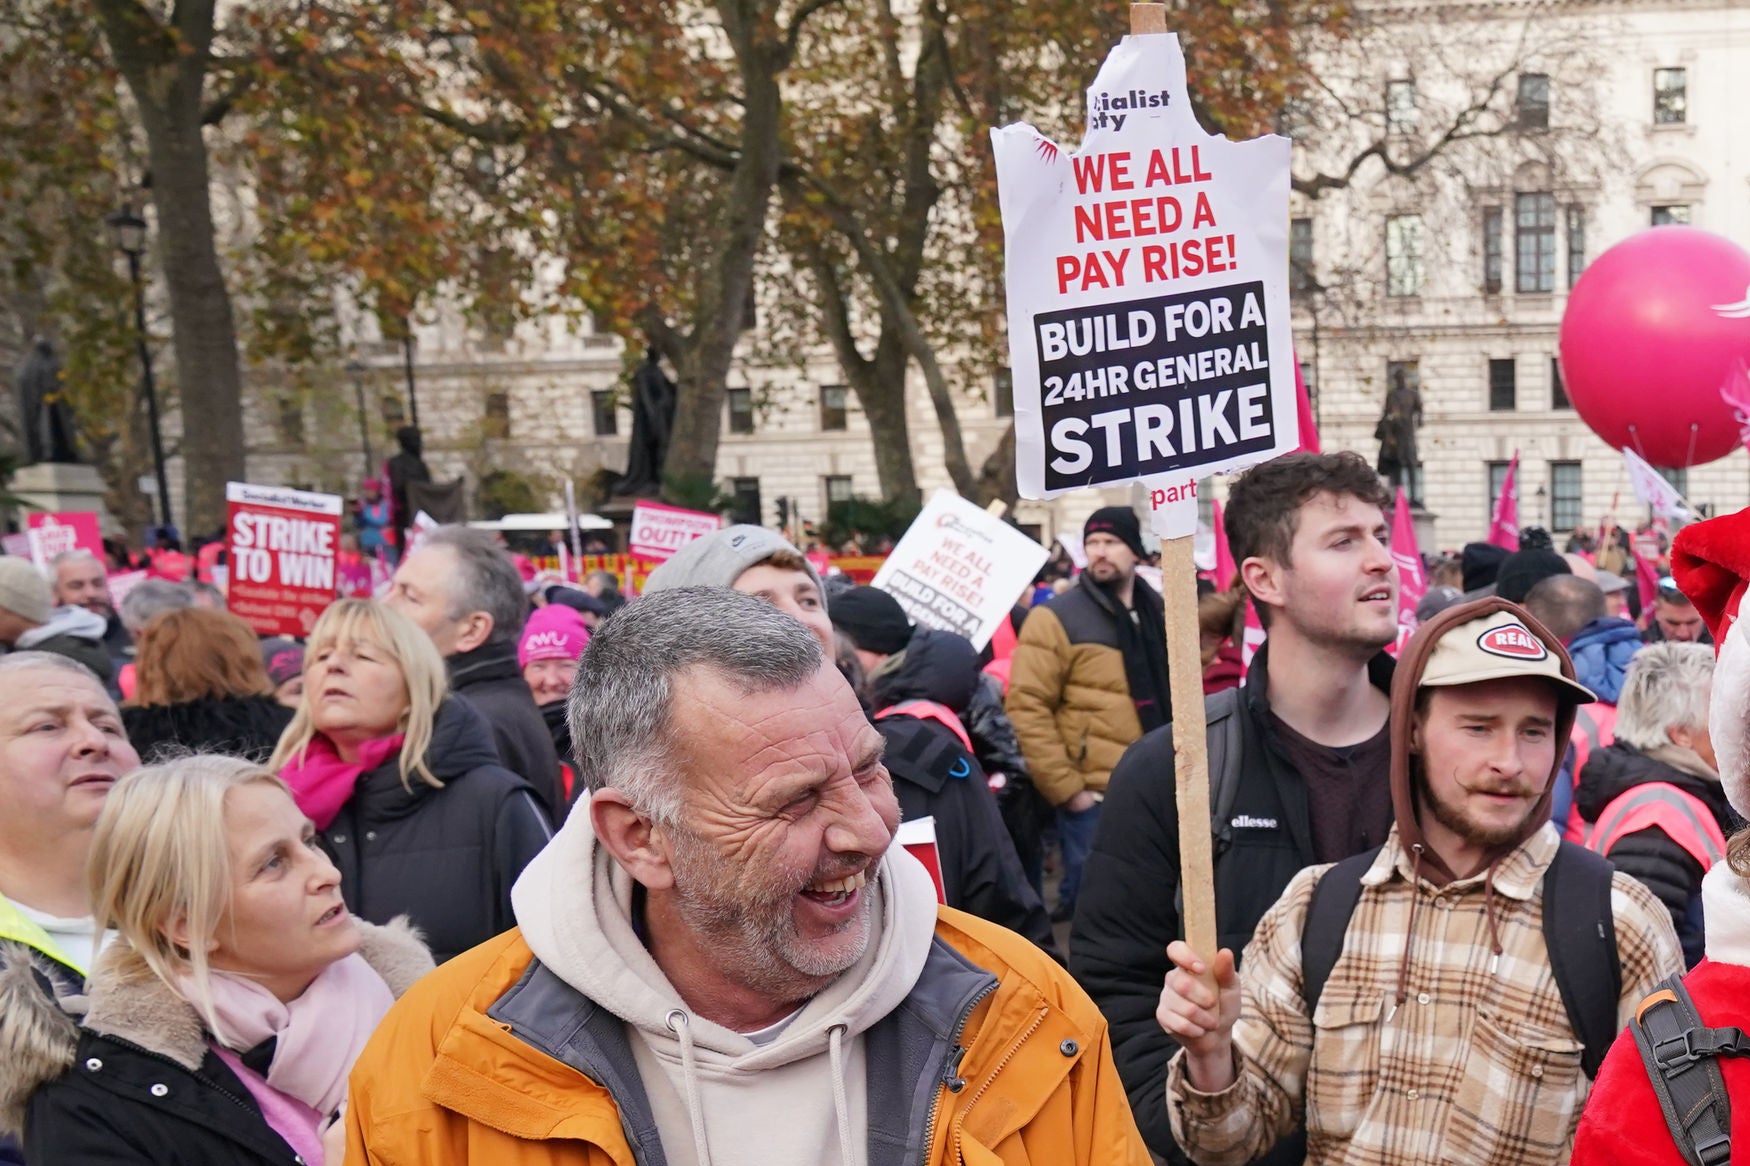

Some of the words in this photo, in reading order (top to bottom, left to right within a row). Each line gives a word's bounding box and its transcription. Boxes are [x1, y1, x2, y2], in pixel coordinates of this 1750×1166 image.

[1094, 90, 1170, 111] ialist
[1072, 152, 1134, 195] WE
[1145, 145, 1212, 187] ALL
[1074, 196, 1182, 243] NEED
[1193, 191, 1216, 229] A
[1056, 248, 1131, 294] PAY
[1142, 234, 1237, 283] RISE!
[1040, 309, 1157, 361] BUILD
[1164, 297, 1234, 342] FOR
[1240, 292, 1265, 329] A
[1044, 365, 1129, 407] 24HR
[1133, 342, 1268, 391] GENERAL
[1050, 383, 1271, 475] STRIKE
[1151, 478, 1198, 511] part
[232, 511, 335, 555] STRIKE
[638, 526, 687, 546] OUT!
[231, 546, 272, 583] TO
[278, 551, 334, 590] WIN
[931, 550, 970, 580] NEED
[942, 537, 964, 554] WE
[965, 553, 994, 577] ALL
[1494, 632, 1535, 650] REAL
[1231, 815, 1277, 828] ellesse
